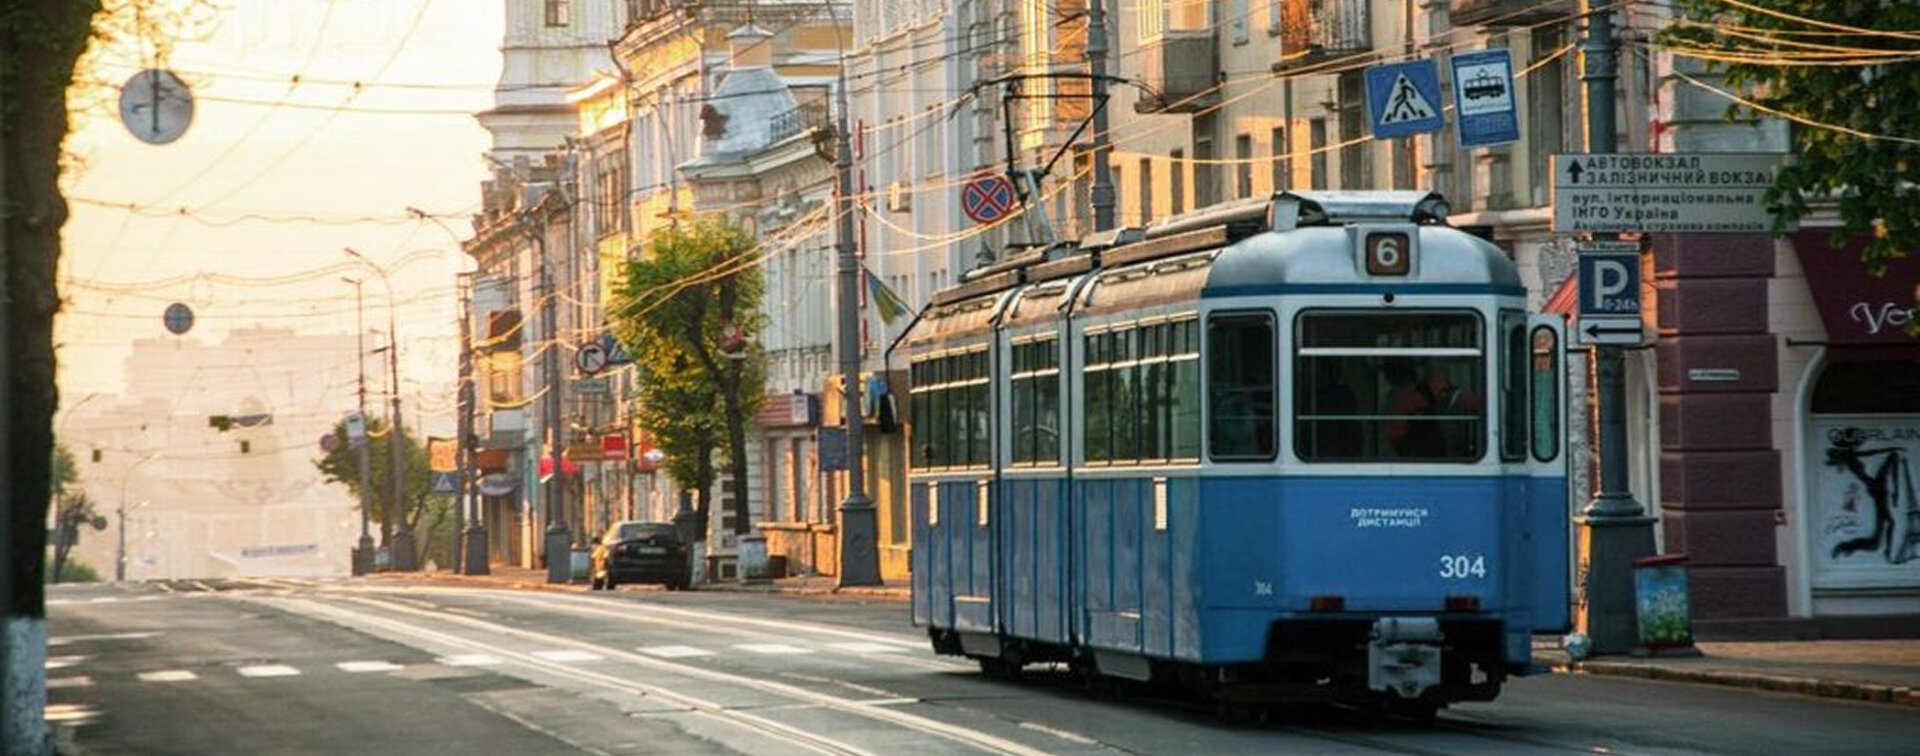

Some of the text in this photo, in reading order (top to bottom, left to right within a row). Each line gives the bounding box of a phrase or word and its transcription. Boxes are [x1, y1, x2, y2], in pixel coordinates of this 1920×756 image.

[1587, 156, 1700, 169] АВТОВОКЗАЛ
[1586, 170, 1705, 184] ЗАЛІЗНИЧНИЙ
[1614, 206, 1678, 221] Україна
[1376, 237, 1399, 266] 6
[1594, 260, 1629, 309] P
[1439, 555, 1486, 579] 304
